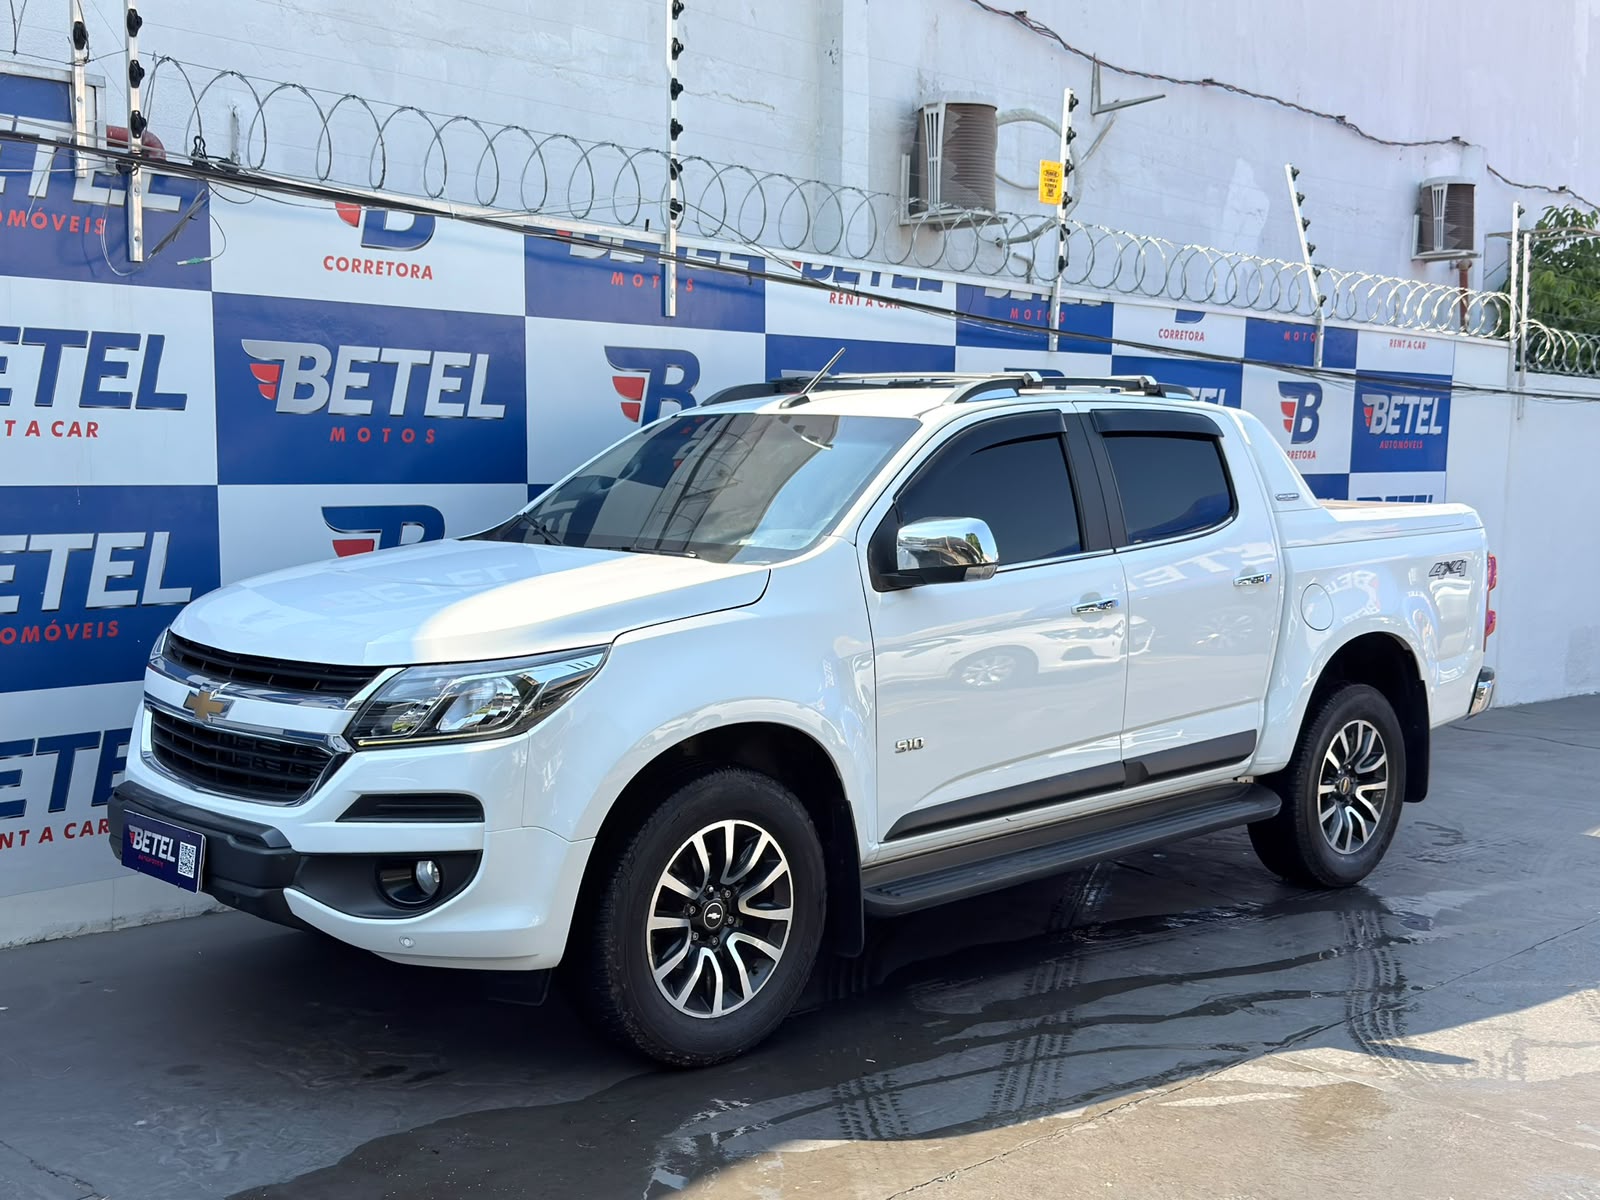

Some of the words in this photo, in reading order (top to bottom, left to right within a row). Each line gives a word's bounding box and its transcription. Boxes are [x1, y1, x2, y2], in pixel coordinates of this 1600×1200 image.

[0, 207, 105, 236] MÓVEIS
[323, 255, 433, 280] CORRETORA
[611, 271, 694, 292] MOTS
[1158, 328, 1205, 342] CORRETORA
[1389, 338, 1406, 349] RENT
[1407, 340, 1412, 349] A
[1413, 340, 1427, 350] CAR
[241, 339, 506, 419] BETEL
[1361, 394, 1443, 435] BETEL
[24, 420, 41, 437] A
[51, 420, 99, 438] CAR
[330, 426, 435, 444] MOTOS
[1379, 438, 1424, 449] AUTOMÓVEIS
[895, 737, 925, 754] S10
[38, 826, 54, 844] A
[64, 818, 110, 839] CAR
[128, 824, 176, 863] BETEL
